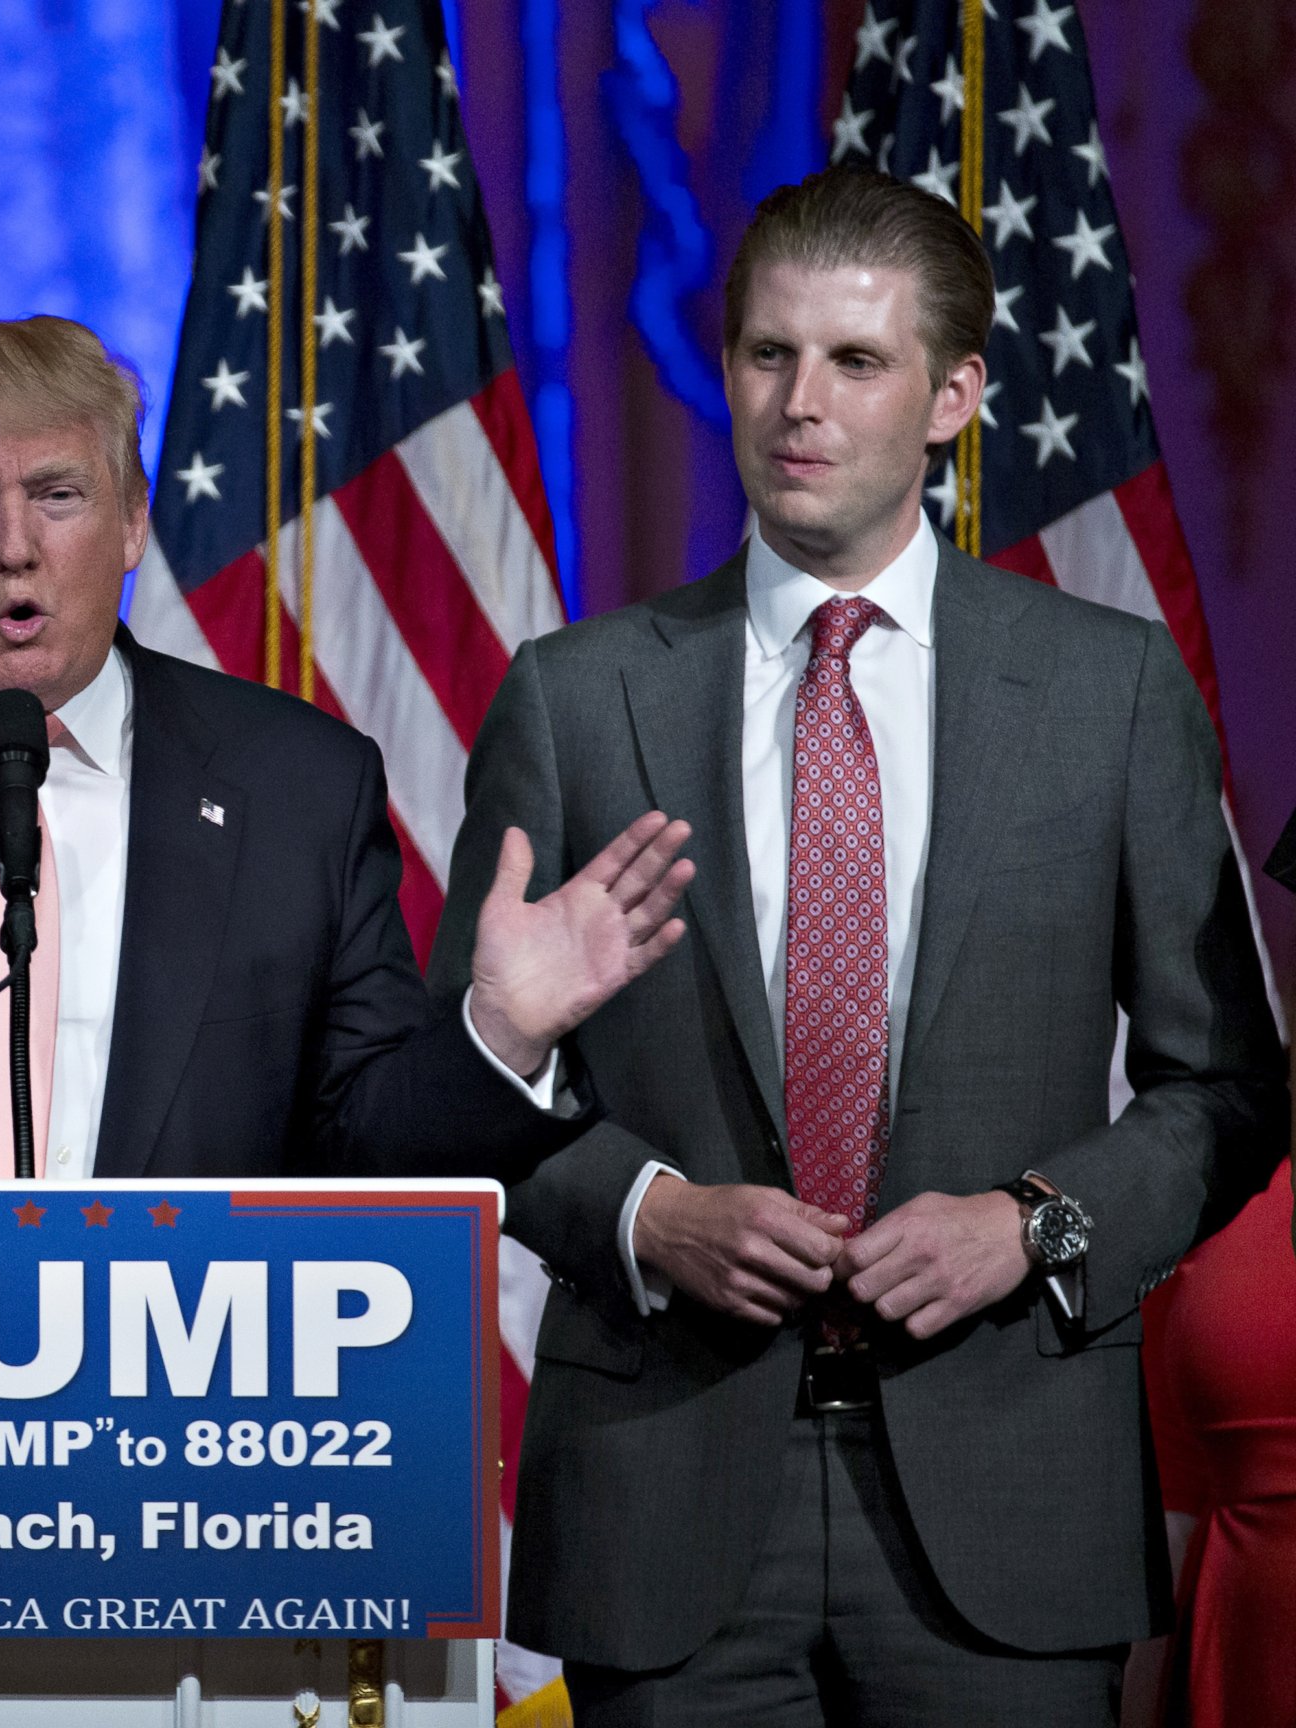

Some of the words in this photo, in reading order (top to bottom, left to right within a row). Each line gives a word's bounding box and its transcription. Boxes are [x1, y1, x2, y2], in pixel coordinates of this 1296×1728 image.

[117, 1430, 167, 1467] to
[184, 1420, 392, 1467] 88022
[142, 1502, 373, 1550] Florida
[63, 1598, 226, 1630] GREAT
[239, 1598, 410, 1630] AGAIN!
